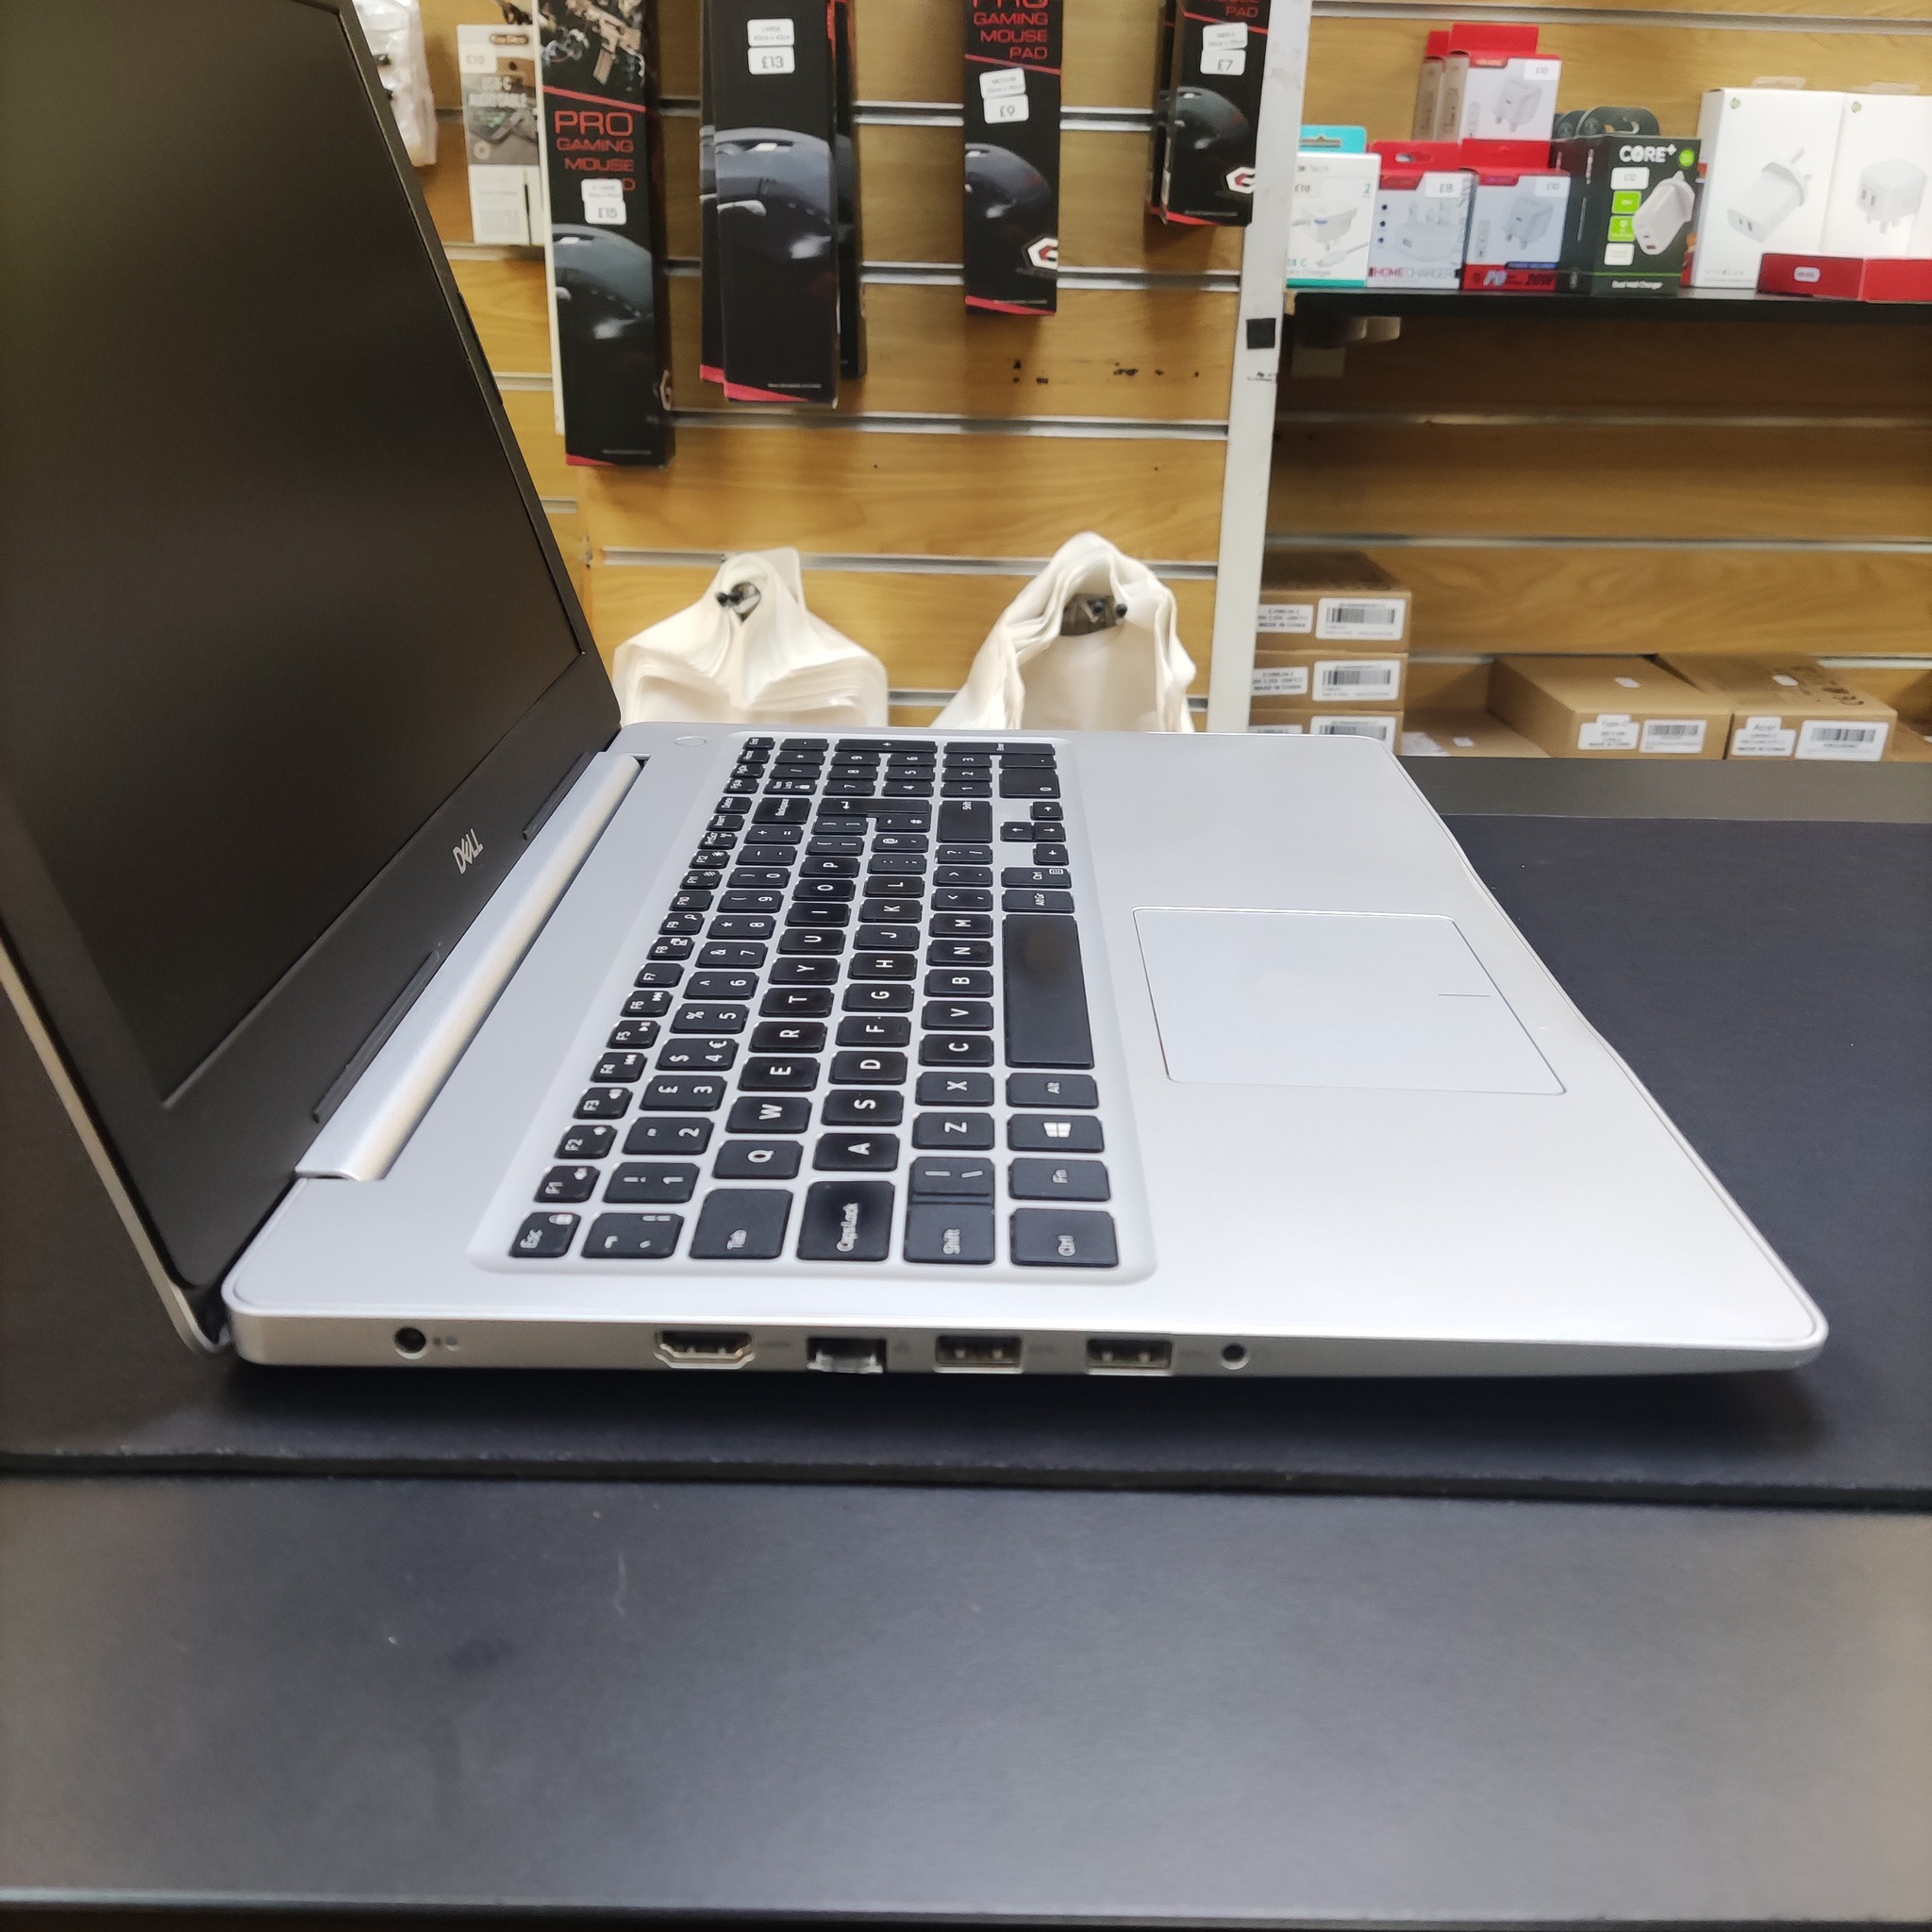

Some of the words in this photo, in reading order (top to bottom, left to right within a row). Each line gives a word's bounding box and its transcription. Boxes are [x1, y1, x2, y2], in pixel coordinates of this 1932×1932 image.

[974, 11, 1049, 25] GAMING
[980, 29, 1048, 43] MOUSE
[1009, 46, 1048, 59] PAD
[761, 56, 784, 70] £13
[1217, 58, 1234, 71] £7
[999, 106, 1016, 118] £9
[554, 110, 634, 137] PRO
[557, 138, 634, 153] GAMING
[564, 158, 635, 172] MOUSE
[597, 207, 618, 219] £15
[453, 828, 483, 874] DELL
[696, 855, 708, 864] F12
[687, 875, 699, 884] F11
[676, 896, 691, 906] F10
[666, 921, 679, 929] F9
[955, 919, 972, 927] M
[655, 945, 669, 954] F8
[954, 946, 971, 955] N
[796, 964, 815, 973] Y
[875, 958, 894, 969] H
[642, 972, 657, 981] F7
[952, 976, 971, 985] B
[788, 995, 808, 1004] T
[871, 991, 890, 1000] G
[629, 1000, 645, 1010] F6
[950, 1008, 970, 1017] V
[779, 1029, 800, 1038] R
[865, 1024, 885, 1033] F
[615, 1030, 632, 1041] F5
[948, 1041, 970, 1053] C
[705, 1054, 724, 1063] 4
[859, 1058, 881, 1070] D
[600, 1063, 616, 1074] F4
[770, 1066, 791, 1075] E
[692, 1085, 713, 1094] 3
[946, 1080, 968, 1091] X
[583, 1099, 600, 1111] F3
[854, 1099, 876, 1110] S
[758, 1104, 783, 1121] W
[678, 1127, 700, 1138] 2
[944, 1122, 968, 1133] Z
[564, 1138, 584, 1151] F2
[847, 1142, 872, 1156] A
[747, 1149, 774, 1163] Q
[662, 1176, 685, 1185] 1
[1052, 1169, 1069, 1184] Fn
[544, 1181, 563, 1194] F1
[520, 1228, 543, 1249] Esc
[726, 1229, 748, 1250] Tab
[943, 1228, 961, 1256] Shift
[1057, 1235, 1077, 1257] Ctrl
